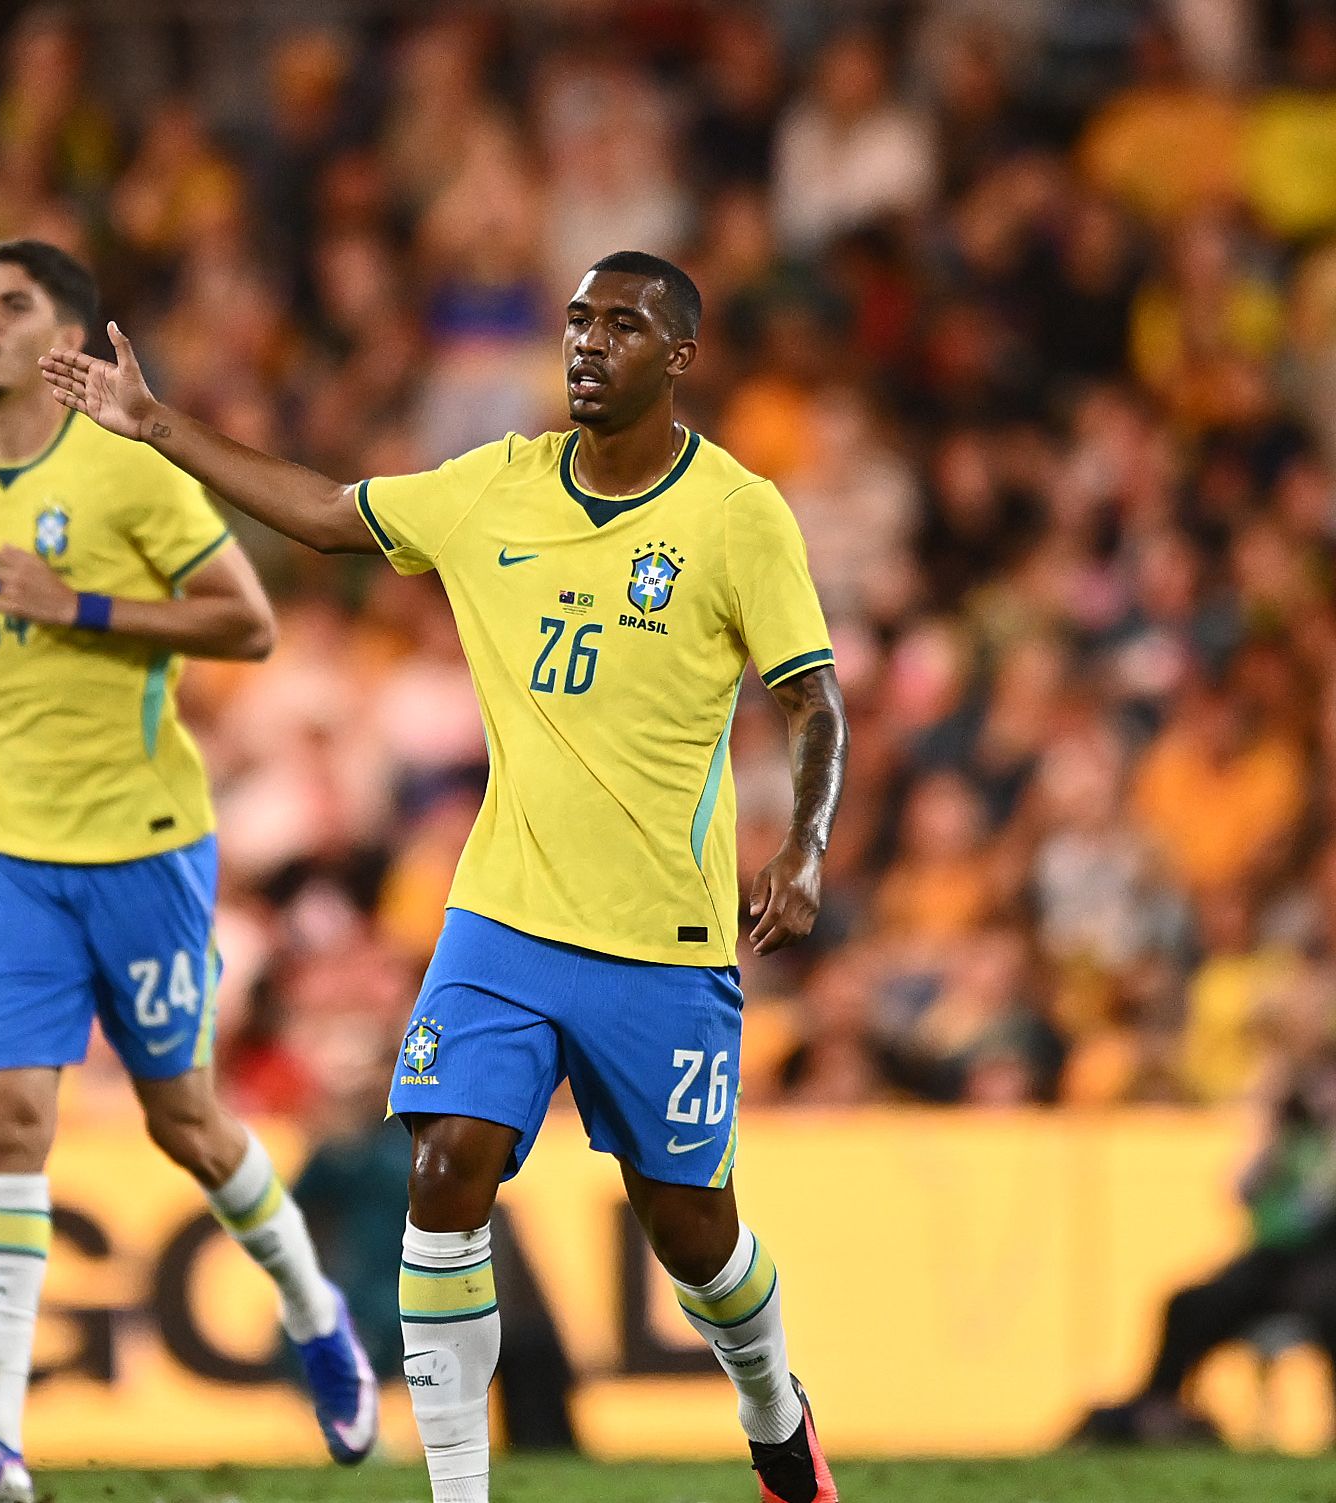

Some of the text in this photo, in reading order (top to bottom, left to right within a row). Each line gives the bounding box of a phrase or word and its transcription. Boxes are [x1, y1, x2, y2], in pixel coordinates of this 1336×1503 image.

[642, 576, 661, 586] CBF
[618, 614, 669, 635] BRASIL
[530, 617, 603, 695] 26
[129, 949, 199, 1027] 24
[400, 1075, 440, 1085] BRASIL
[666, 1049, 728, 1125] 26
[405, 1375, 440, 1387] RASIL
